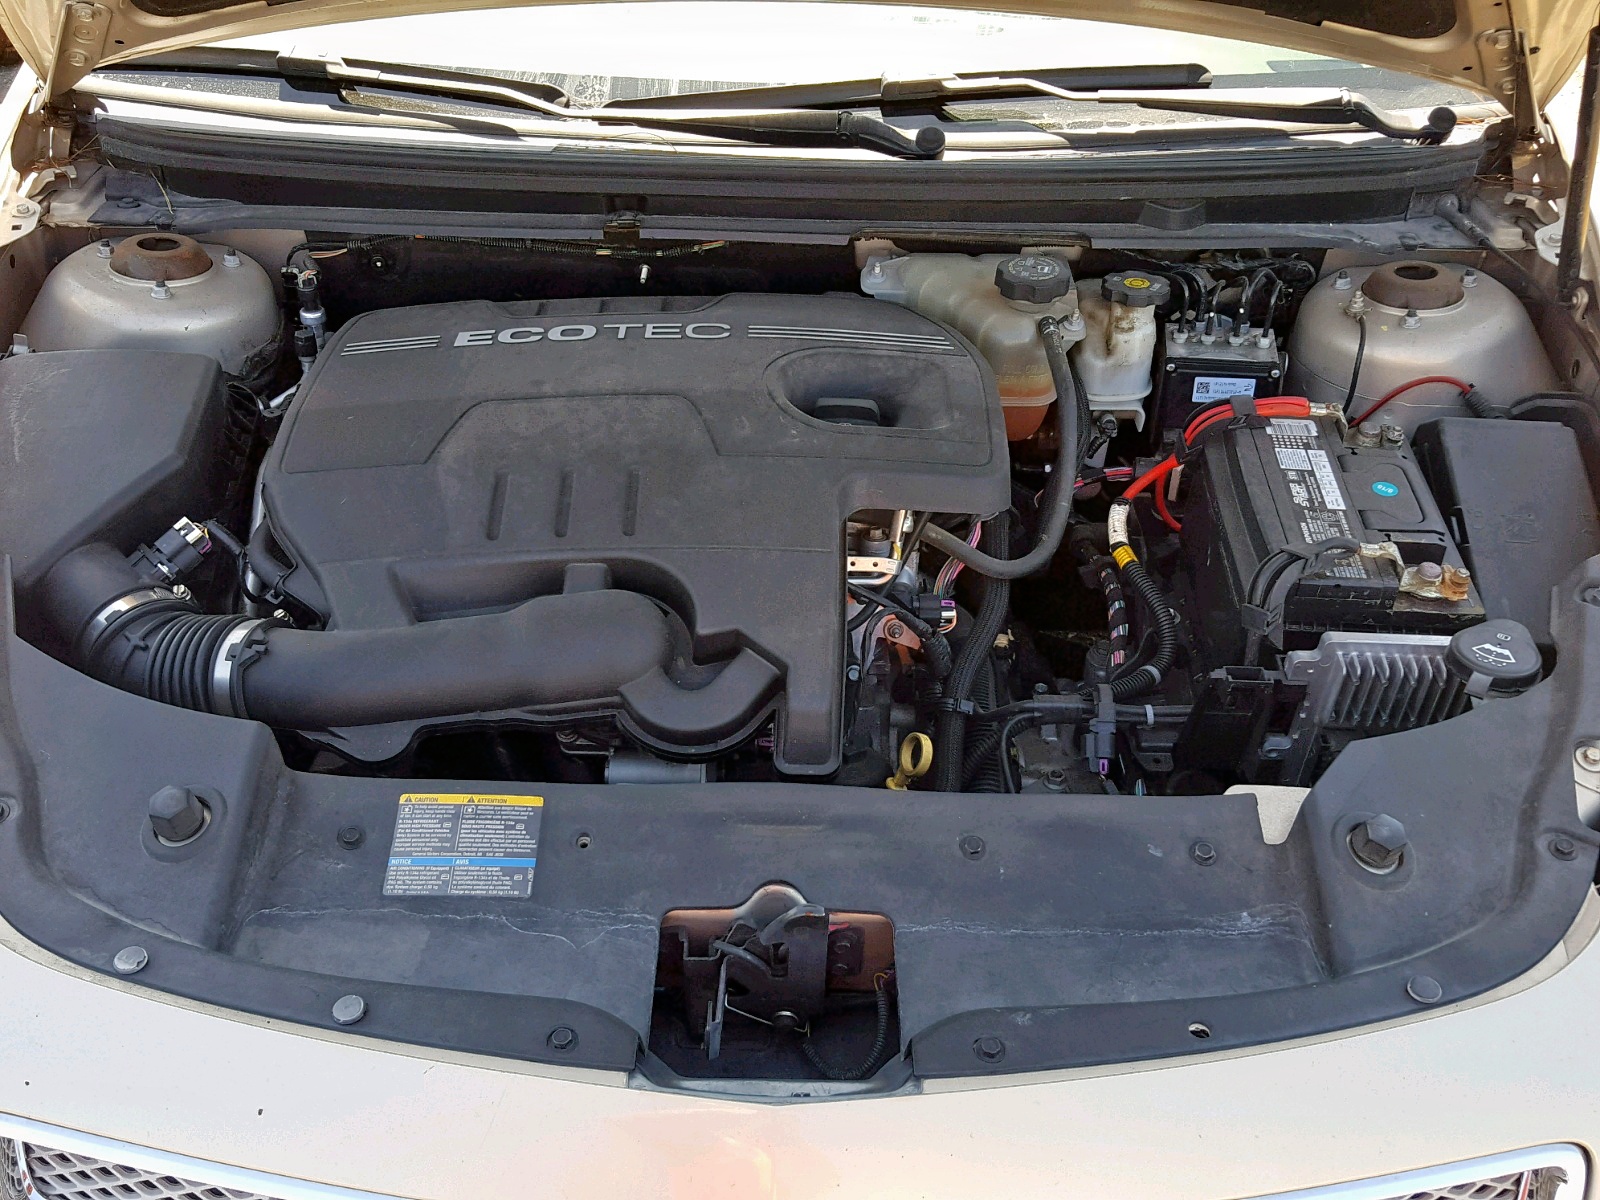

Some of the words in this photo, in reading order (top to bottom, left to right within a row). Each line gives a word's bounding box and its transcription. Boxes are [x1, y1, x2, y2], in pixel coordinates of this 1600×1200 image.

[454, 323, 731, 346] ECOTEC
[1290, 482, 1299, 504] SUPER
[1298, 484, 1310, 507] START
